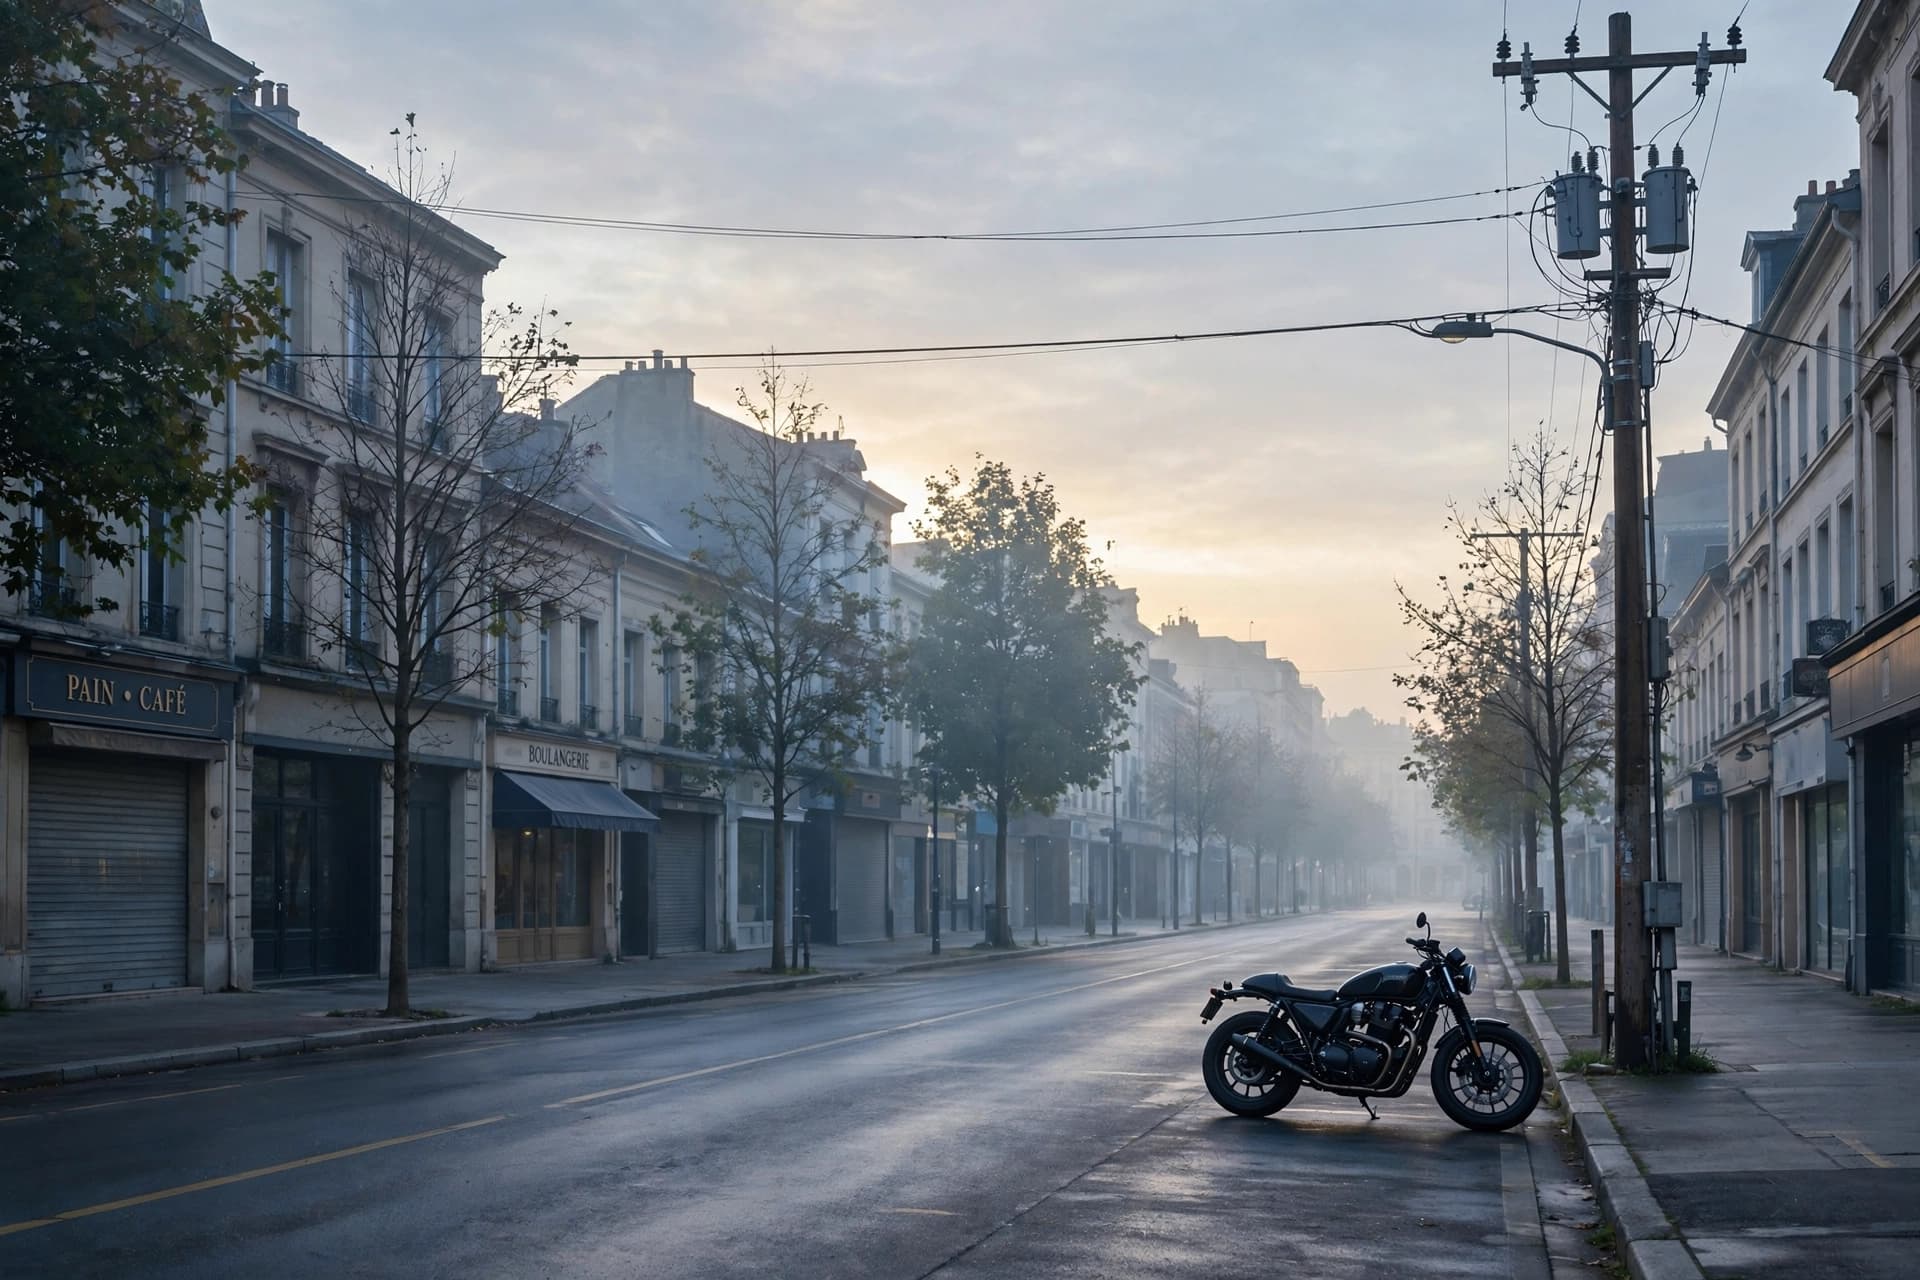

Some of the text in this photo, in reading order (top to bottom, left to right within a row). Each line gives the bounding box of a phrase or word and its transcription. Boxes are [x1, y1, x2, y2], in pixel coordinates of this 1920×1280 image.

[67, 674, 187, 715] PAIN CAFÉ
[529, 745, 589, 770] BOULANGERIE
